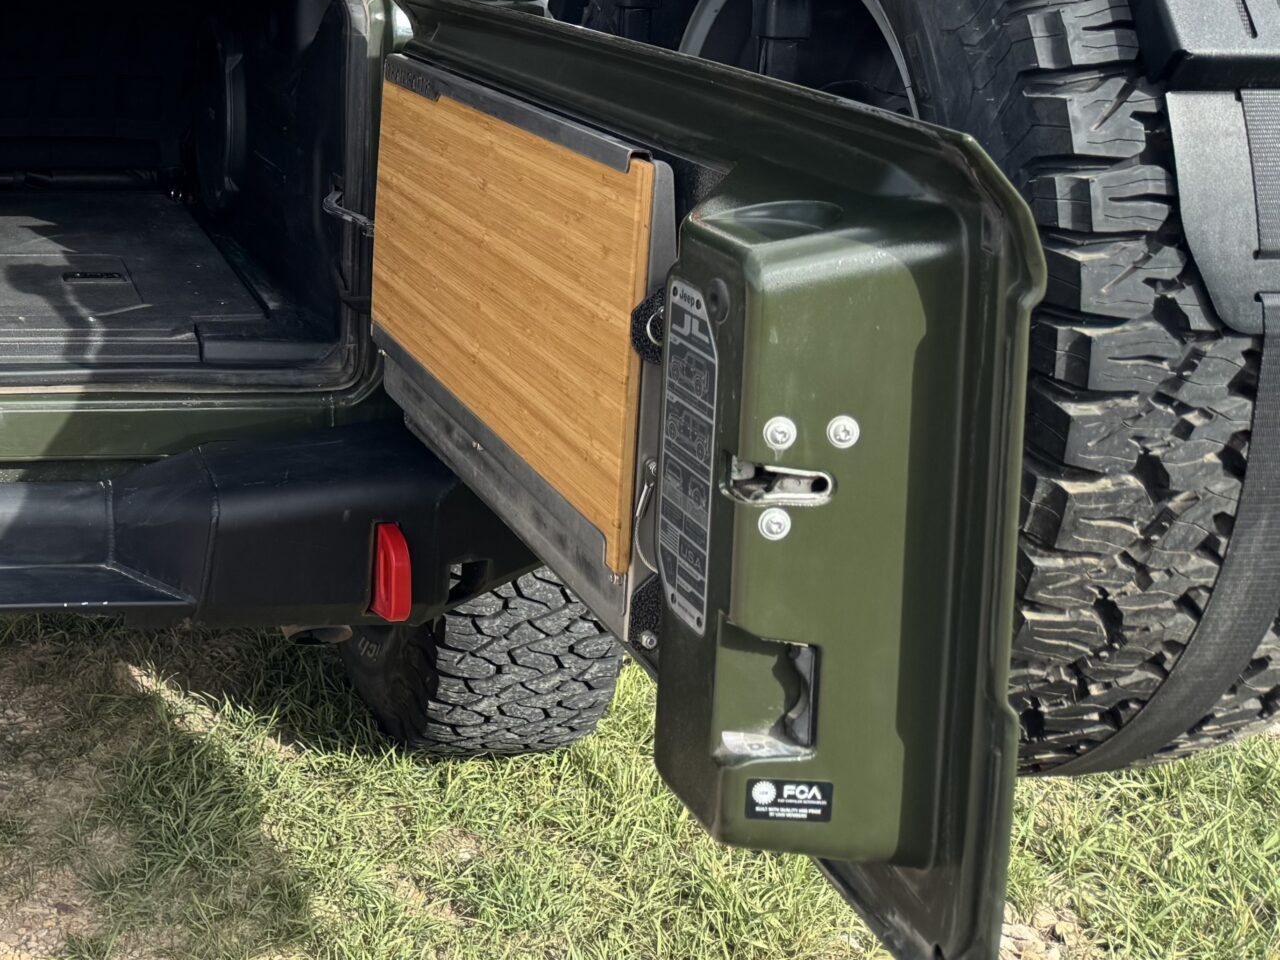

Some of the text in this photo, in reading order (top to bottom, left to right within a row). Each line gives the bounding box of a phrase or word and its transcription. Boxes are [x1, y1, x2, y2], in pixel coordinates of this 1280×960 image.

[680, 288, 695, 307] Jeep
[672, 313, 710, 344] JL
[783, 784, 822, 799] FCA
